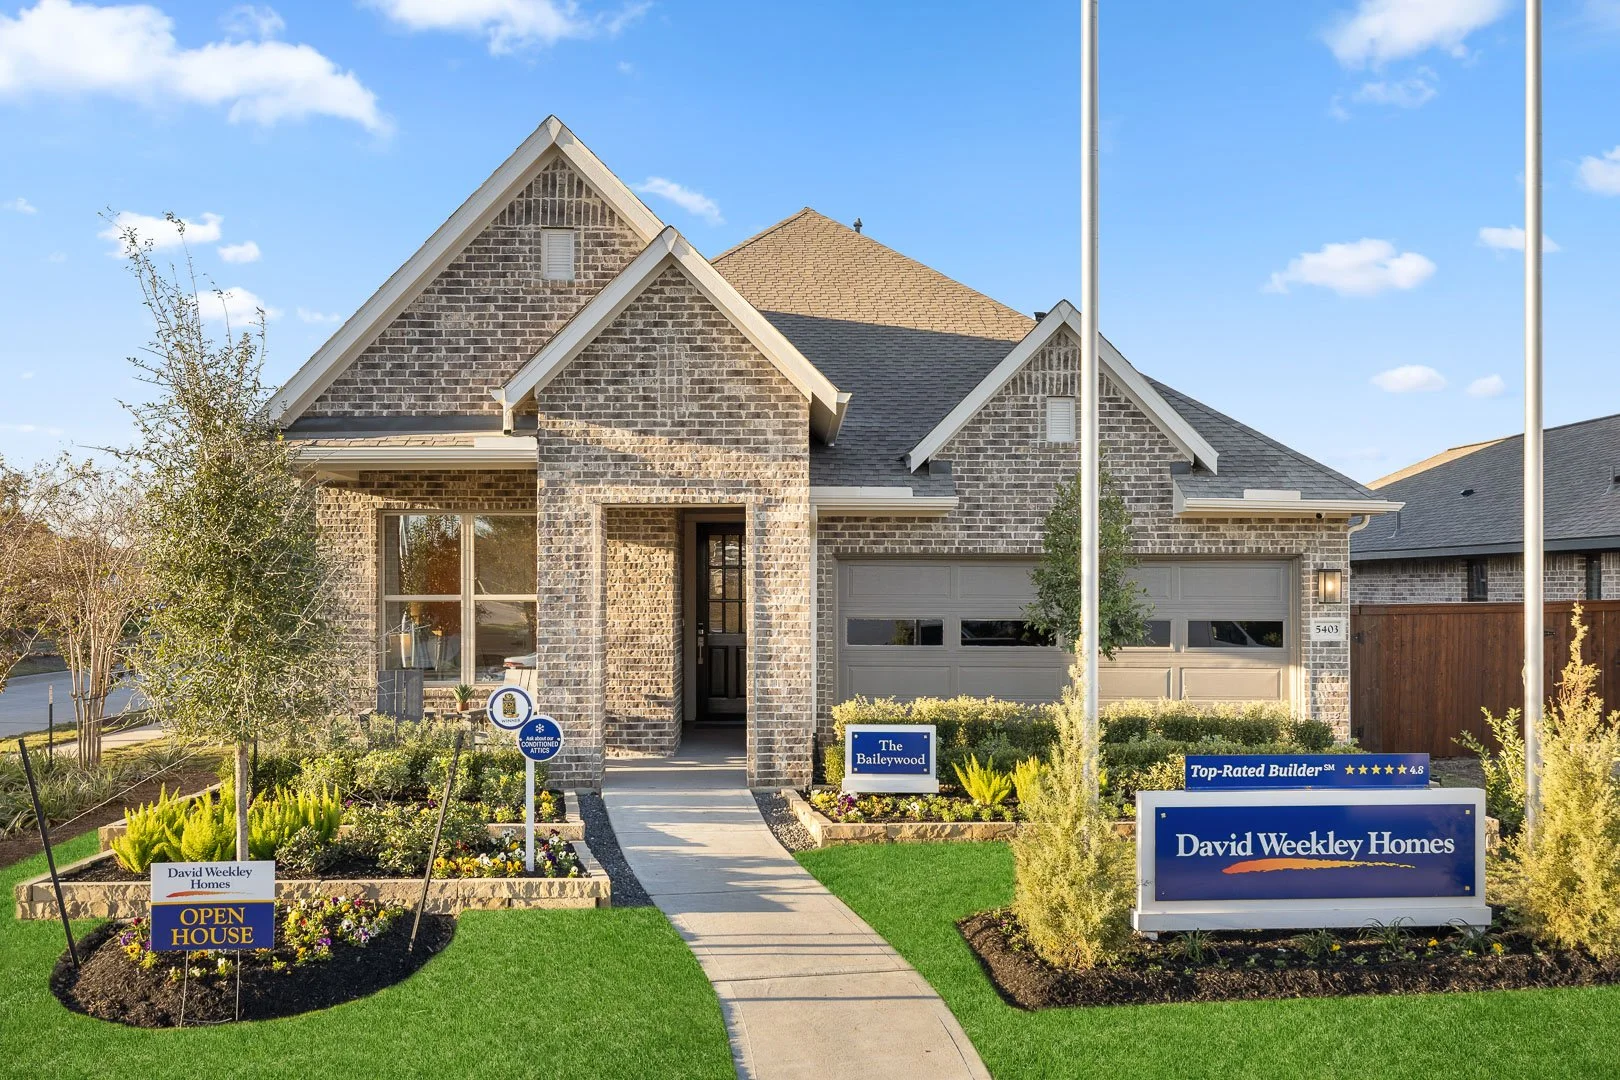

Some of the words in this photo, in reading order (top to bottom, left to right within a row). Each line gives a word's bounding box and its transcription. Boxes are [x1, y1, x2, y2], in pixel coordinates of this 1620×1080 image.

[1316, 625, 1339, 634] 5403
[879, 740, 903, 751] The
[856, 753, 926, 766] Baileywood
[1191, 764, 1265, 781] Top-Rated
[1410, 766, 1424, 774] 4.8
[1176, 832, 1253, 857] David
[1257, 830, 1364, 860] Weekley
[1367, 831, 1455, 855] Homes
[168, 867, 202, 878] David
[205, 866, 252, 879] Weekley
[191, 880, 231, 889] Homes
[180, 907, 245, 926] OPEN
[171, 926, 254, 945] HOUSE
